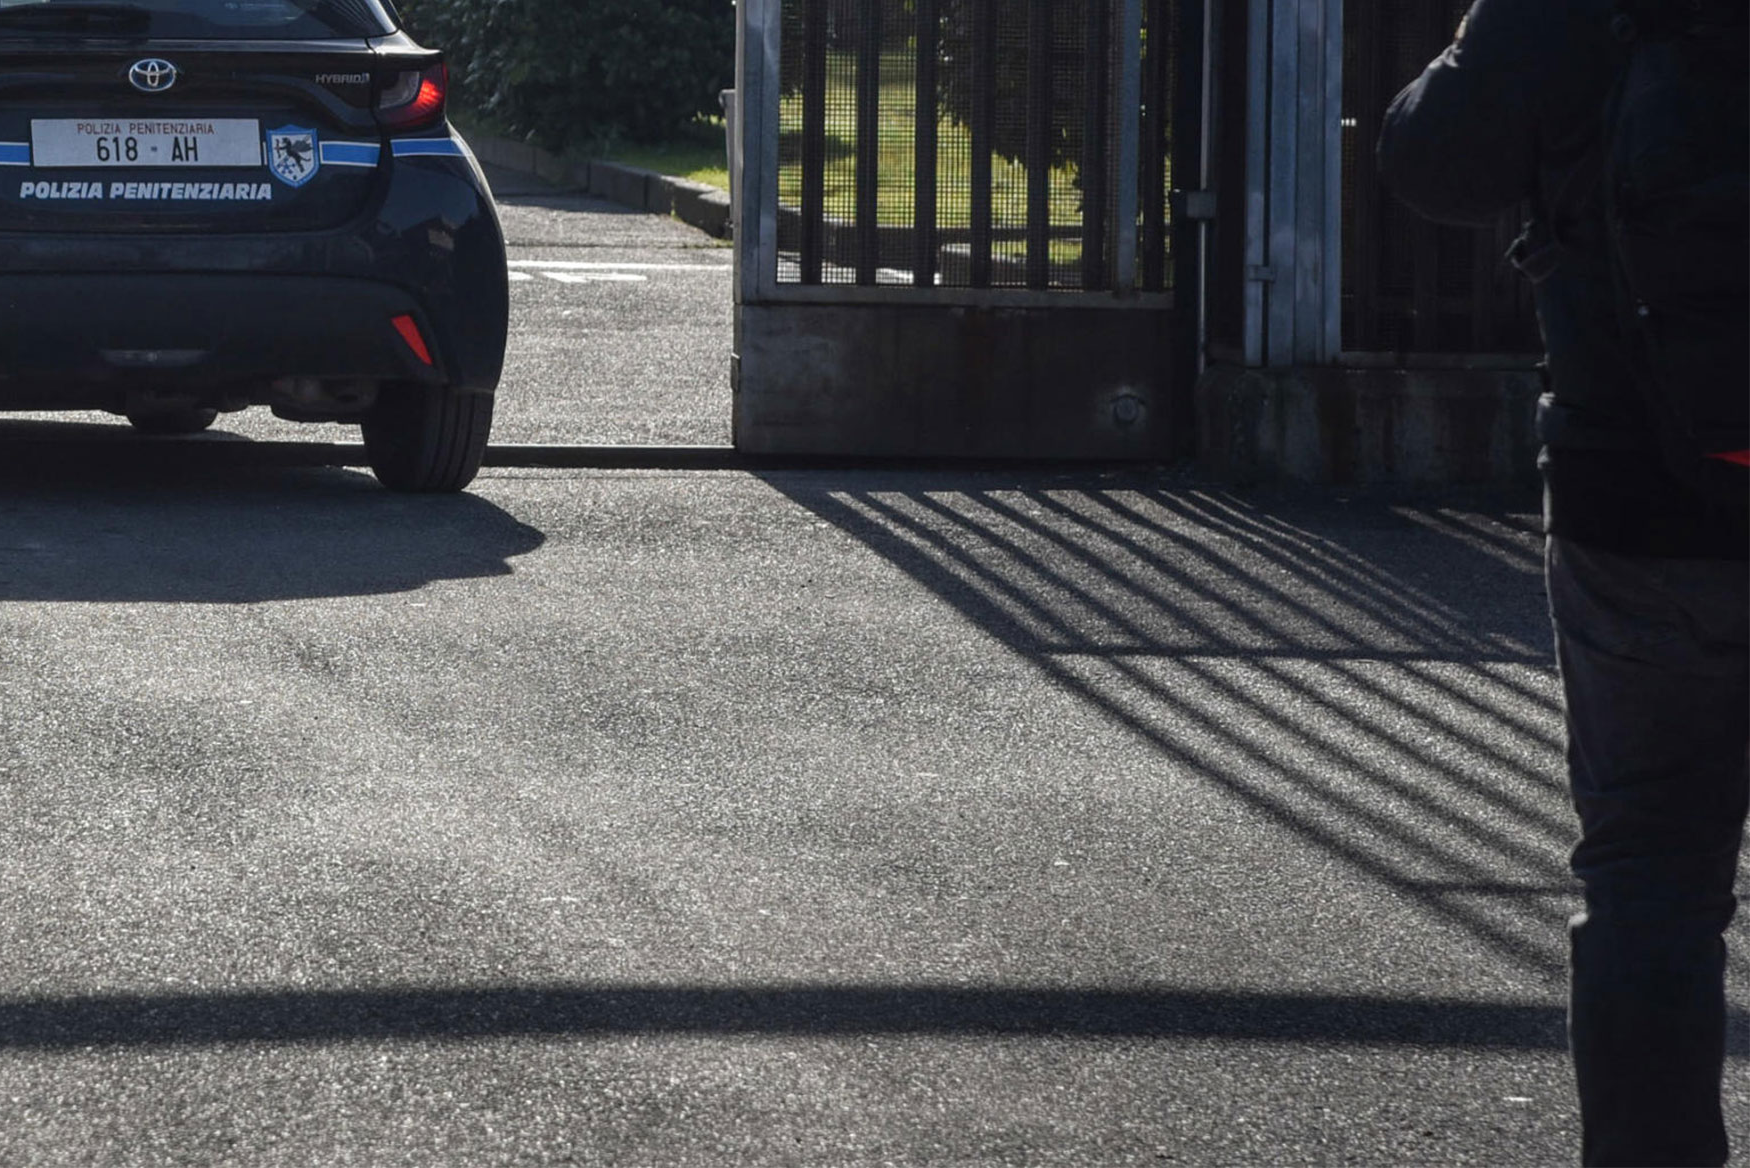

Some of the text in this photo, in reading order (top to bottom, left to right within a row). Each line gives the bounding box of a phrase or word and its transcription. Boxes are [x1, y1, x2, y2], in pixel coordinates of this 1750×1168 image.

[315, 73, 362, 84] HYBRID
[77, 122, 215, 136] POLIZIA PENITENZIARIA
[96, 136, 139, 163] 618
[171, 135, 199, 163] AH
[19, 181, 273, 201] POLIZIA PENITENZIARIA
